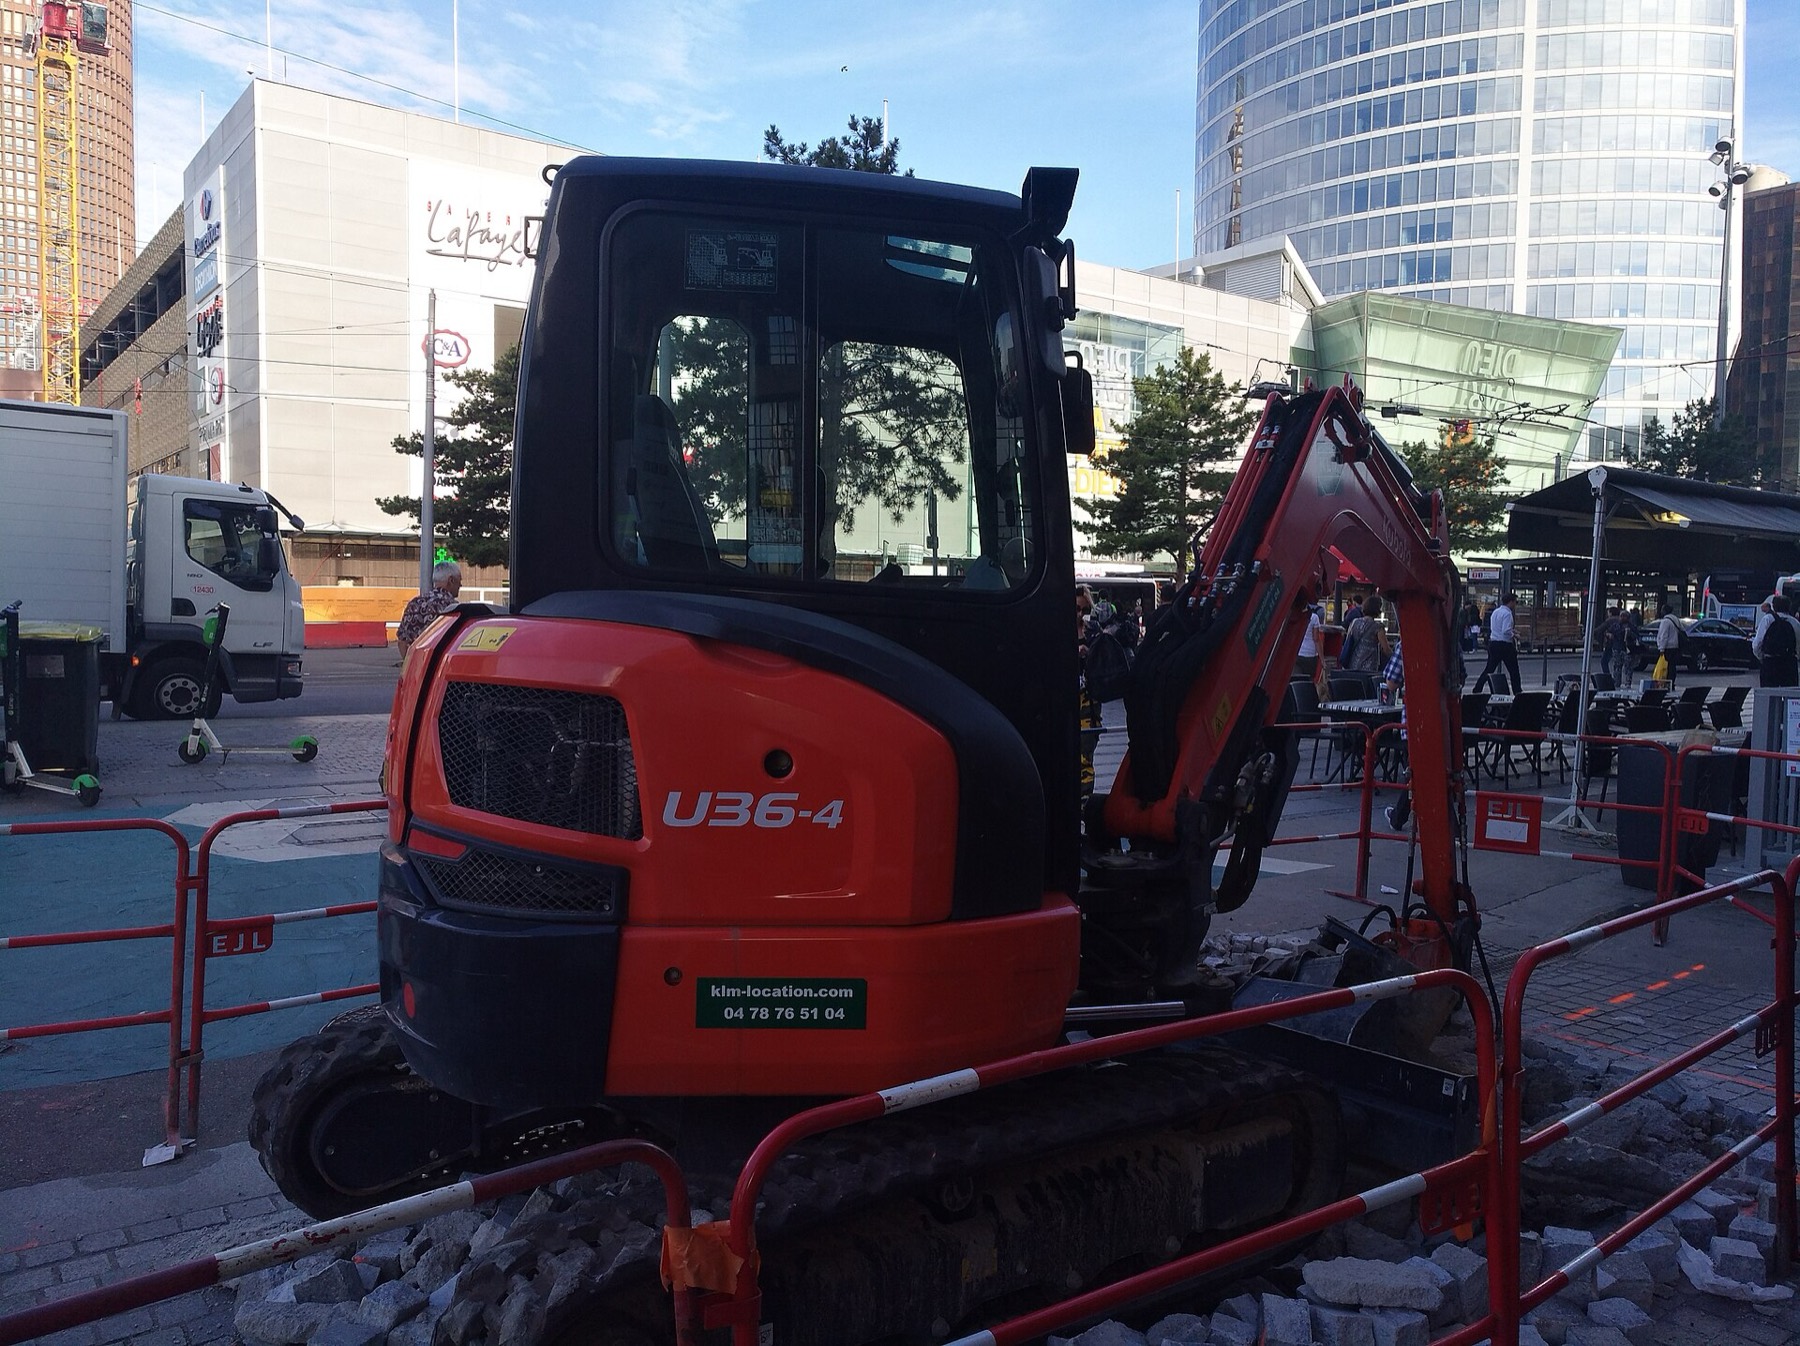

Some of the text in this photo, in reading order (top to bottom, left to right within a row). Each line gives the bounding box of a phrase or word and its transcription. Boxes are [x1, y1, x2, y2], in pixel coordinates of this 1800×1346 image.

[426, 199, 540, 272] Lafaye
[433, 338, 463, 358] C&A
[662, 791, 844, 829] U36-4
[1487, 800, 1530, 820] EJL
[1681, 817, 1705, 832] EJL
[213, 931, 266, 954] EJL
[711, 985, 853, 998] klm-location.com
[724, 1007, 845, 1021] 04 78 76 51 04
